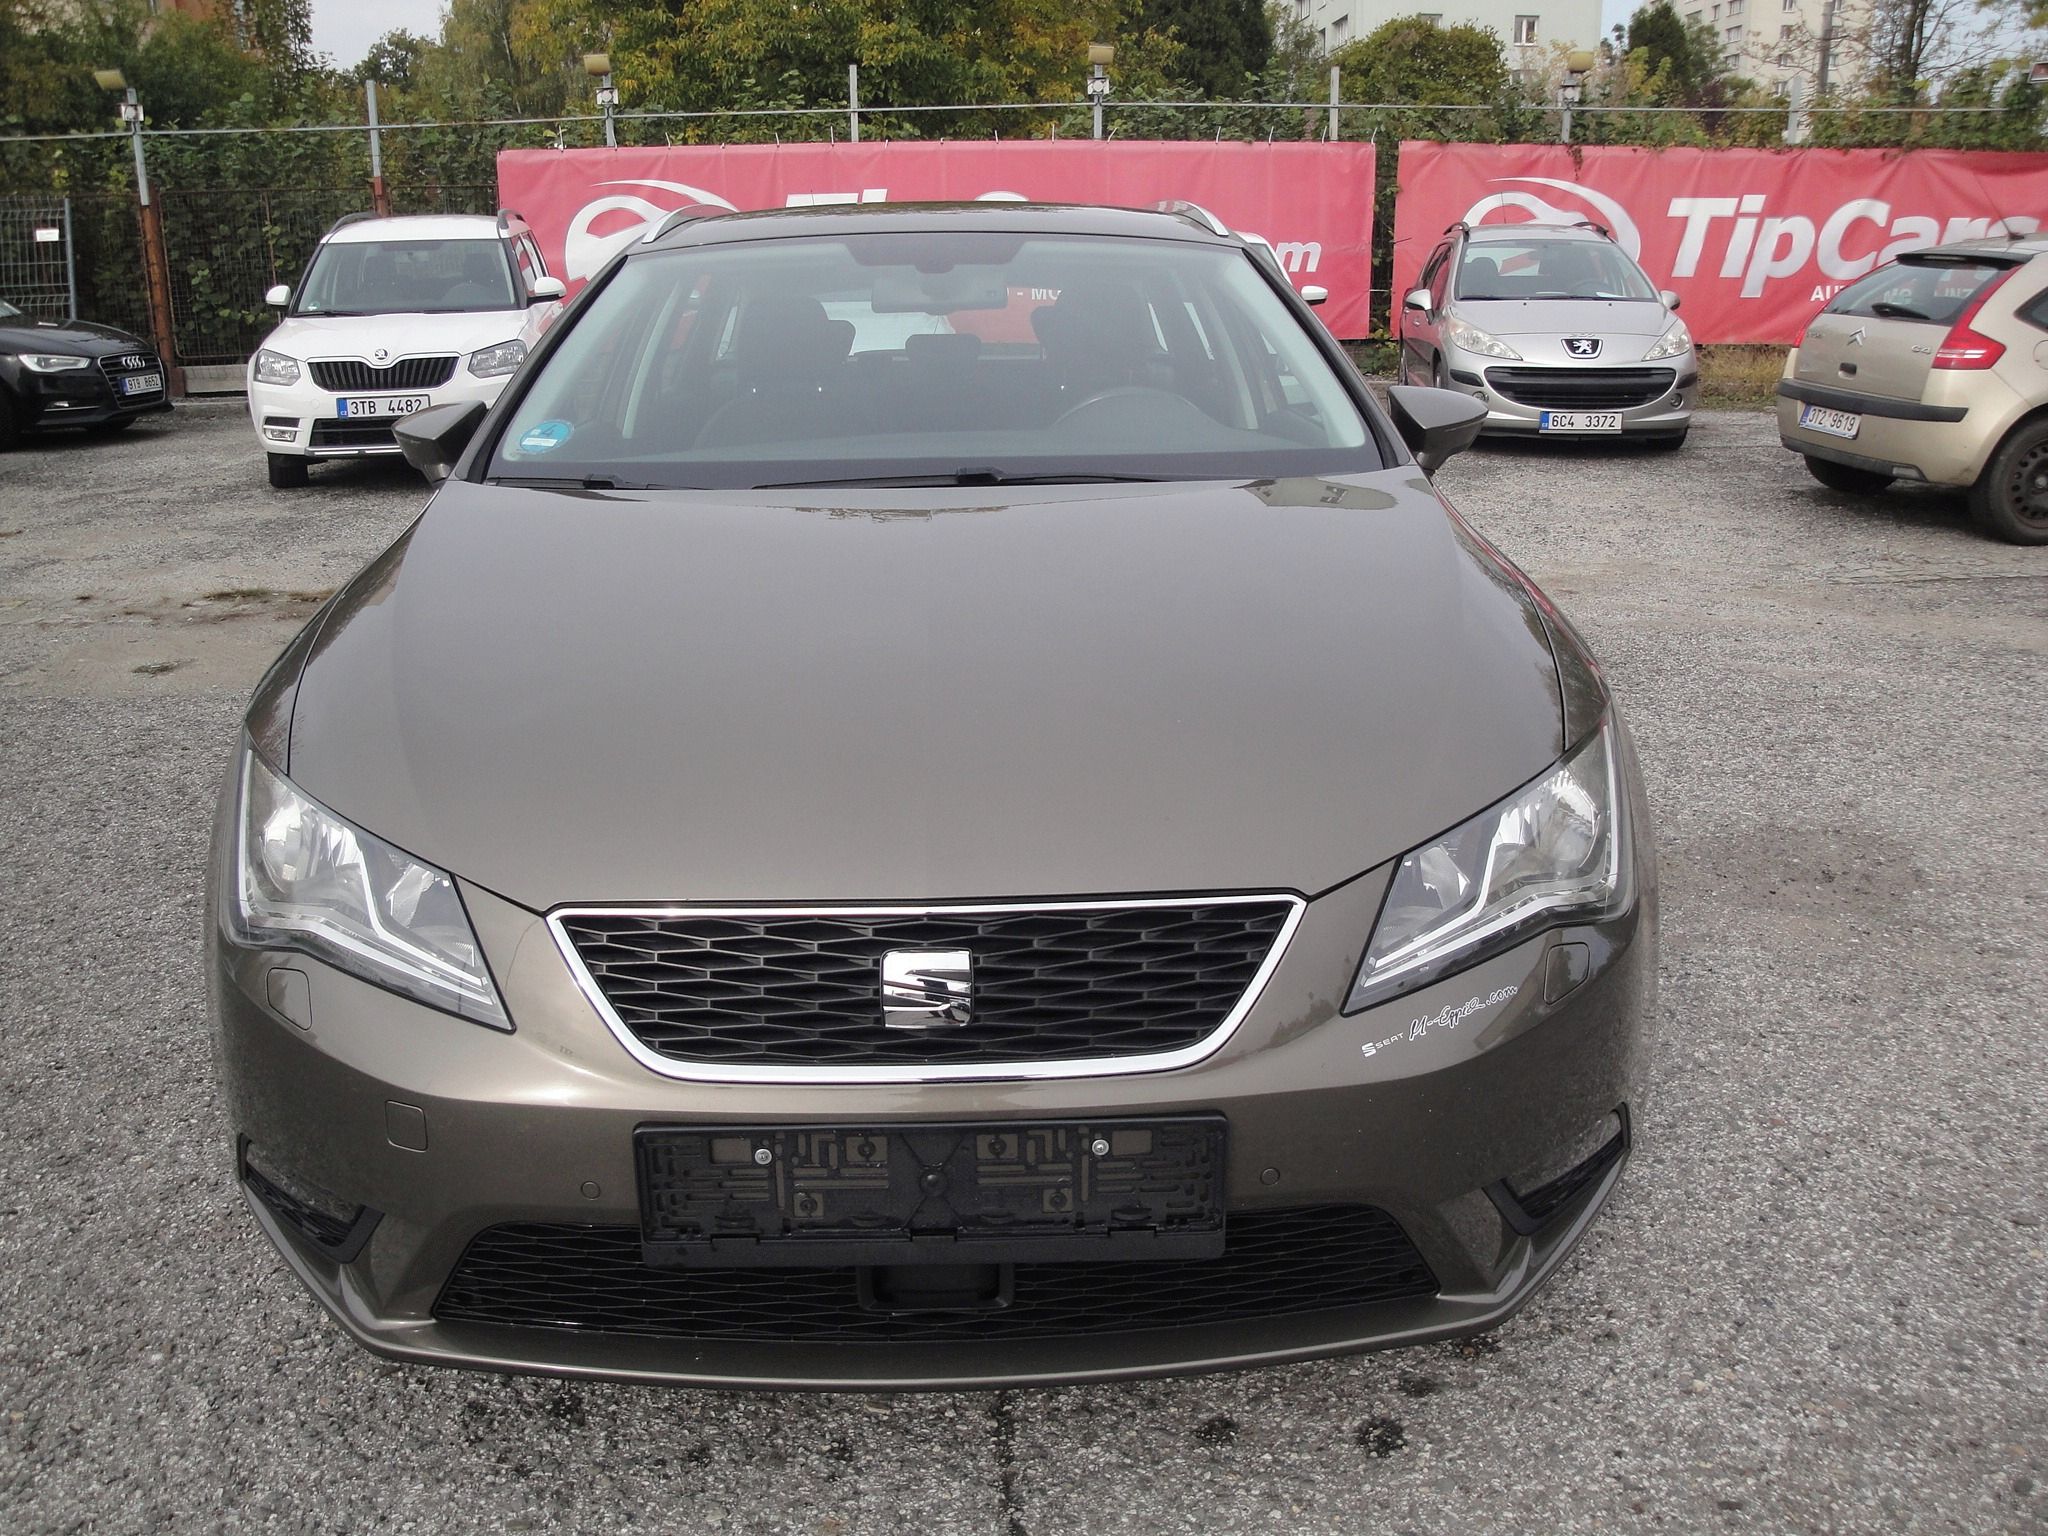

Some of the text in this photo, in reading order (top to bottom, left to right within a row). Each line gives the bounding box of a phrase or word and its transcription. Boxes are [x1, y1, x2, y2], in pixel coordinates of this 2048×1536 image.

[350, 401, 376, 415] 3TB
[1551, 415, 1574, 427] 6C4
[1584, 415, 1616, 428] 3372
